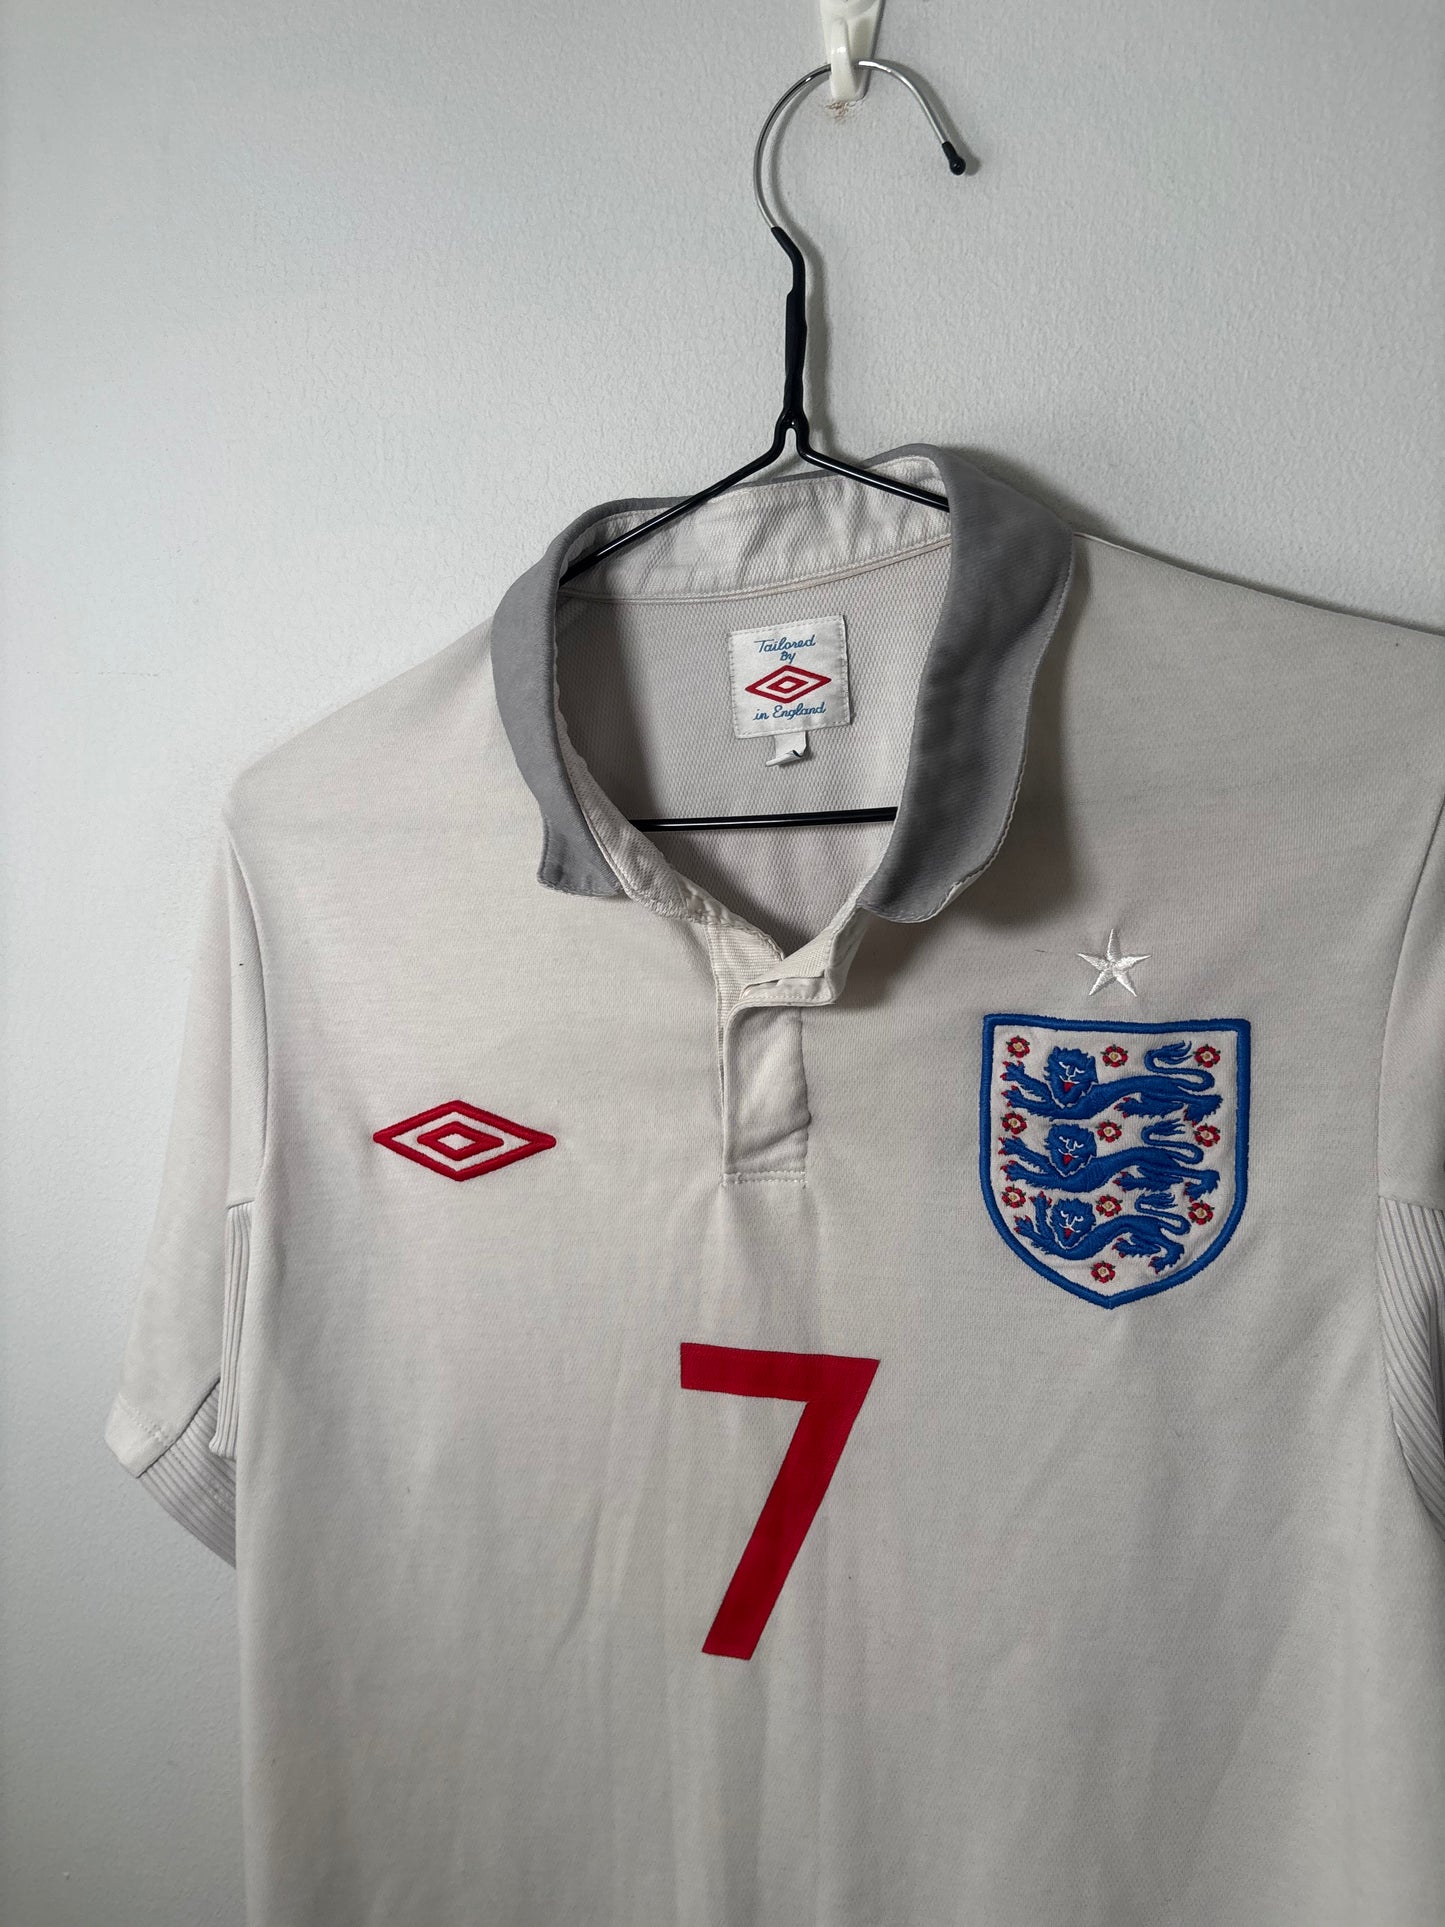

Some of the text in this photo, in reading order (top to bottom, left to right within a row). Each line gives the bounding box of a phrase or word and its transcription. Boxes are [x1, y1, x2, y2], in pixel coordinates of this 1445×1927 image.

[754, 634, 816, 653] Tailored
[753, 702, 827, 721] in England
[680, 1342, 880, 1661] 7
